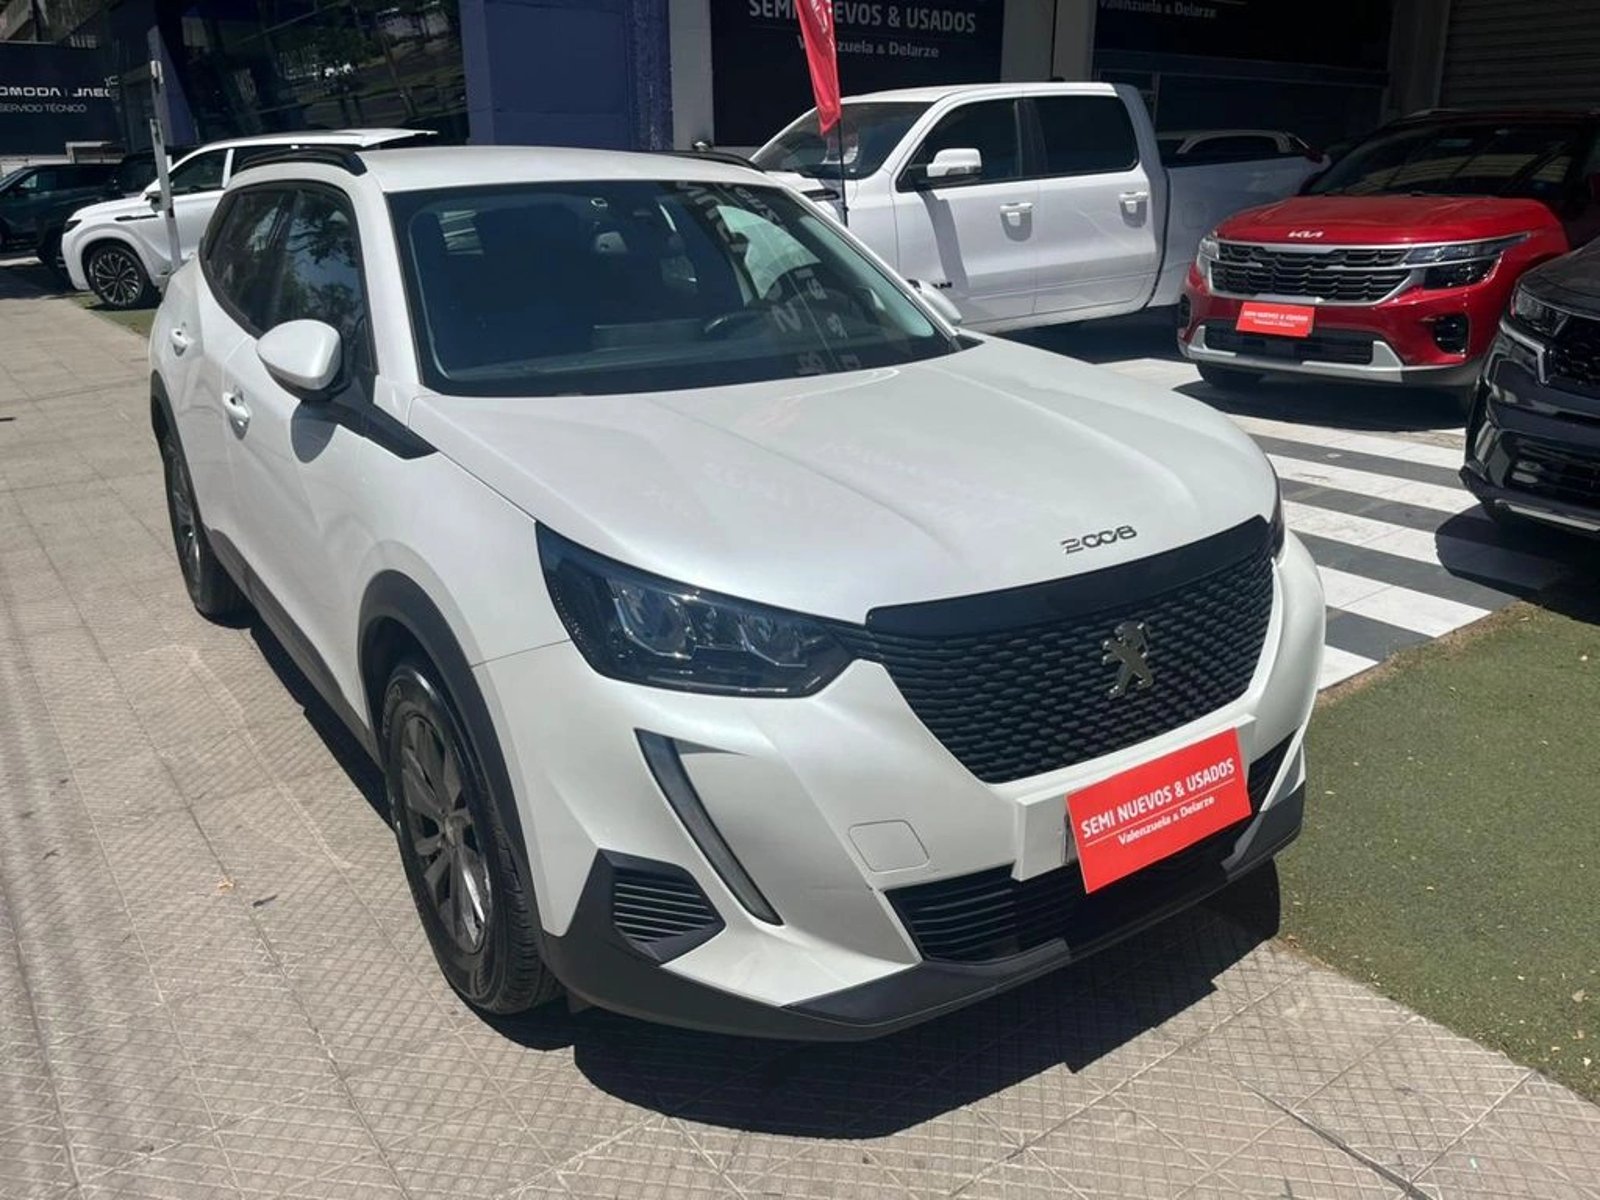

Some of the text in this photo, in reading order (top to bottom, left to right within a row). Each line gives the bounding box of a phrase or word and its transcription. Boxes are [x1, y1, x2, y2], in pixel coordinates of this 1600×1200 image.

[834, 1, 883, 26] EVOS
[887, 6, 901, 28] &
[906, 8, 977, 33] USADOS
[889, 41, 939, 58] Delarze
[1060, 525, 1138, 554] 2008
[1081, 758, 1235, 838] SEMI NUEVOS & USADOS
[1118, 816, 1171, 845] Valenzuela
[1180, 796, 1215, 818] Delarze
